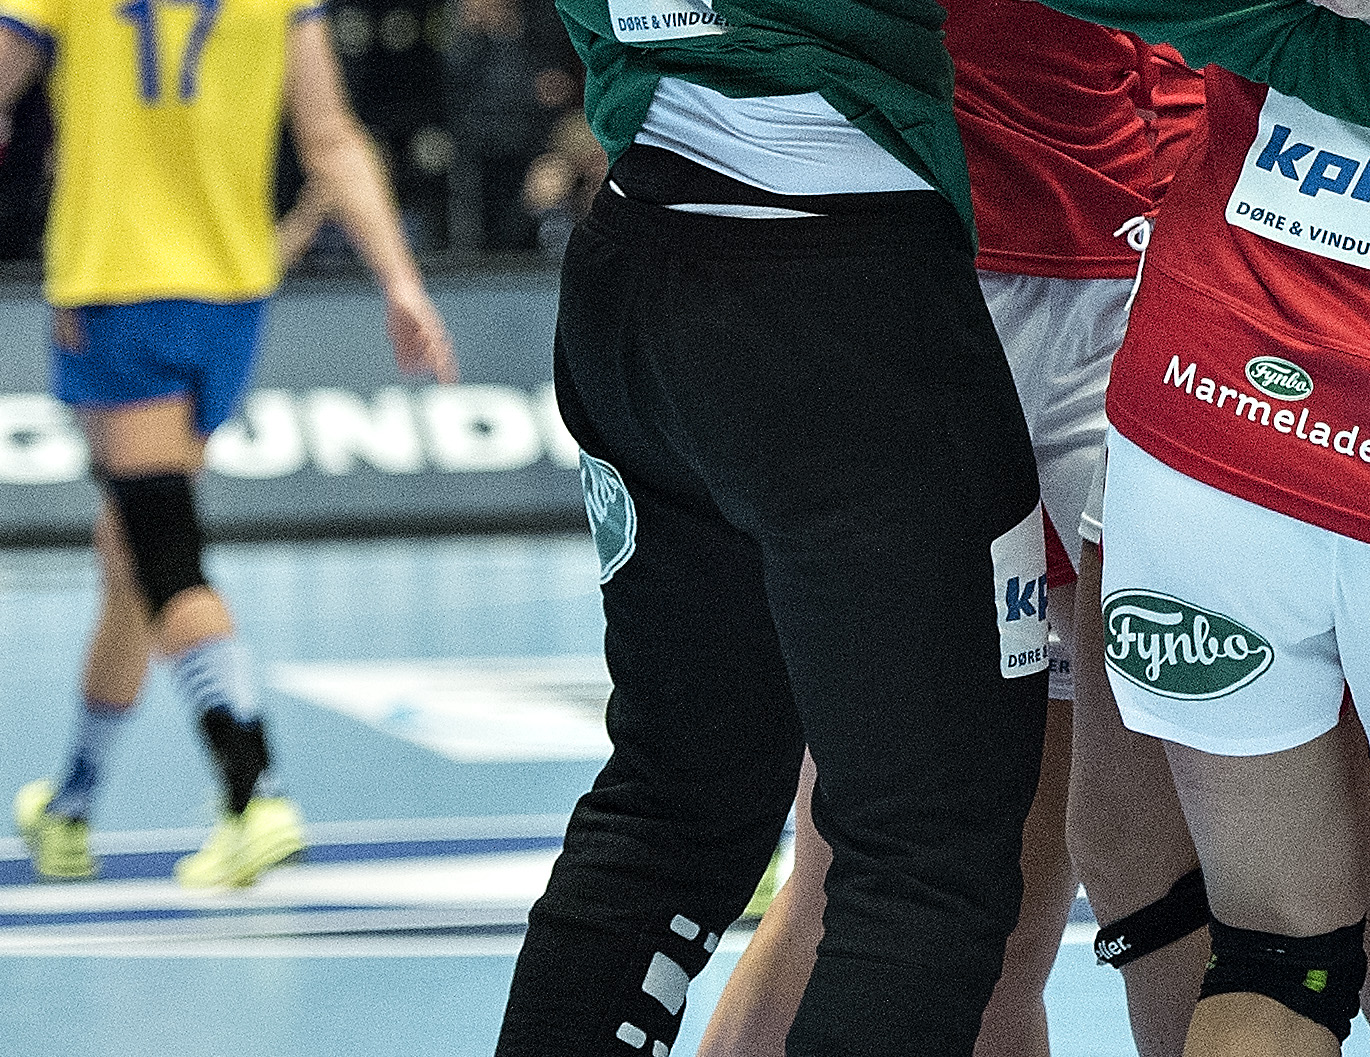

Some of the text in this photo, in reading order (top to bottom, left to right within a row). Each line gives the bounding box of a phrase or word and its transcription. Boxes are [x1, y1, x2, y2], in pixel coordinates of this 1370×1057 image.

[618, 11, 729, 32] DØRE & VINDUE
[1235, 201, 1287, 232] DØRE
[1288, 220, 1304, 237] &
[1250, 362, 1309, 392] Fynbo
[1008, 648, 1041, 668] DØRE
[1106, 604, 1262, 682] Fynbo
